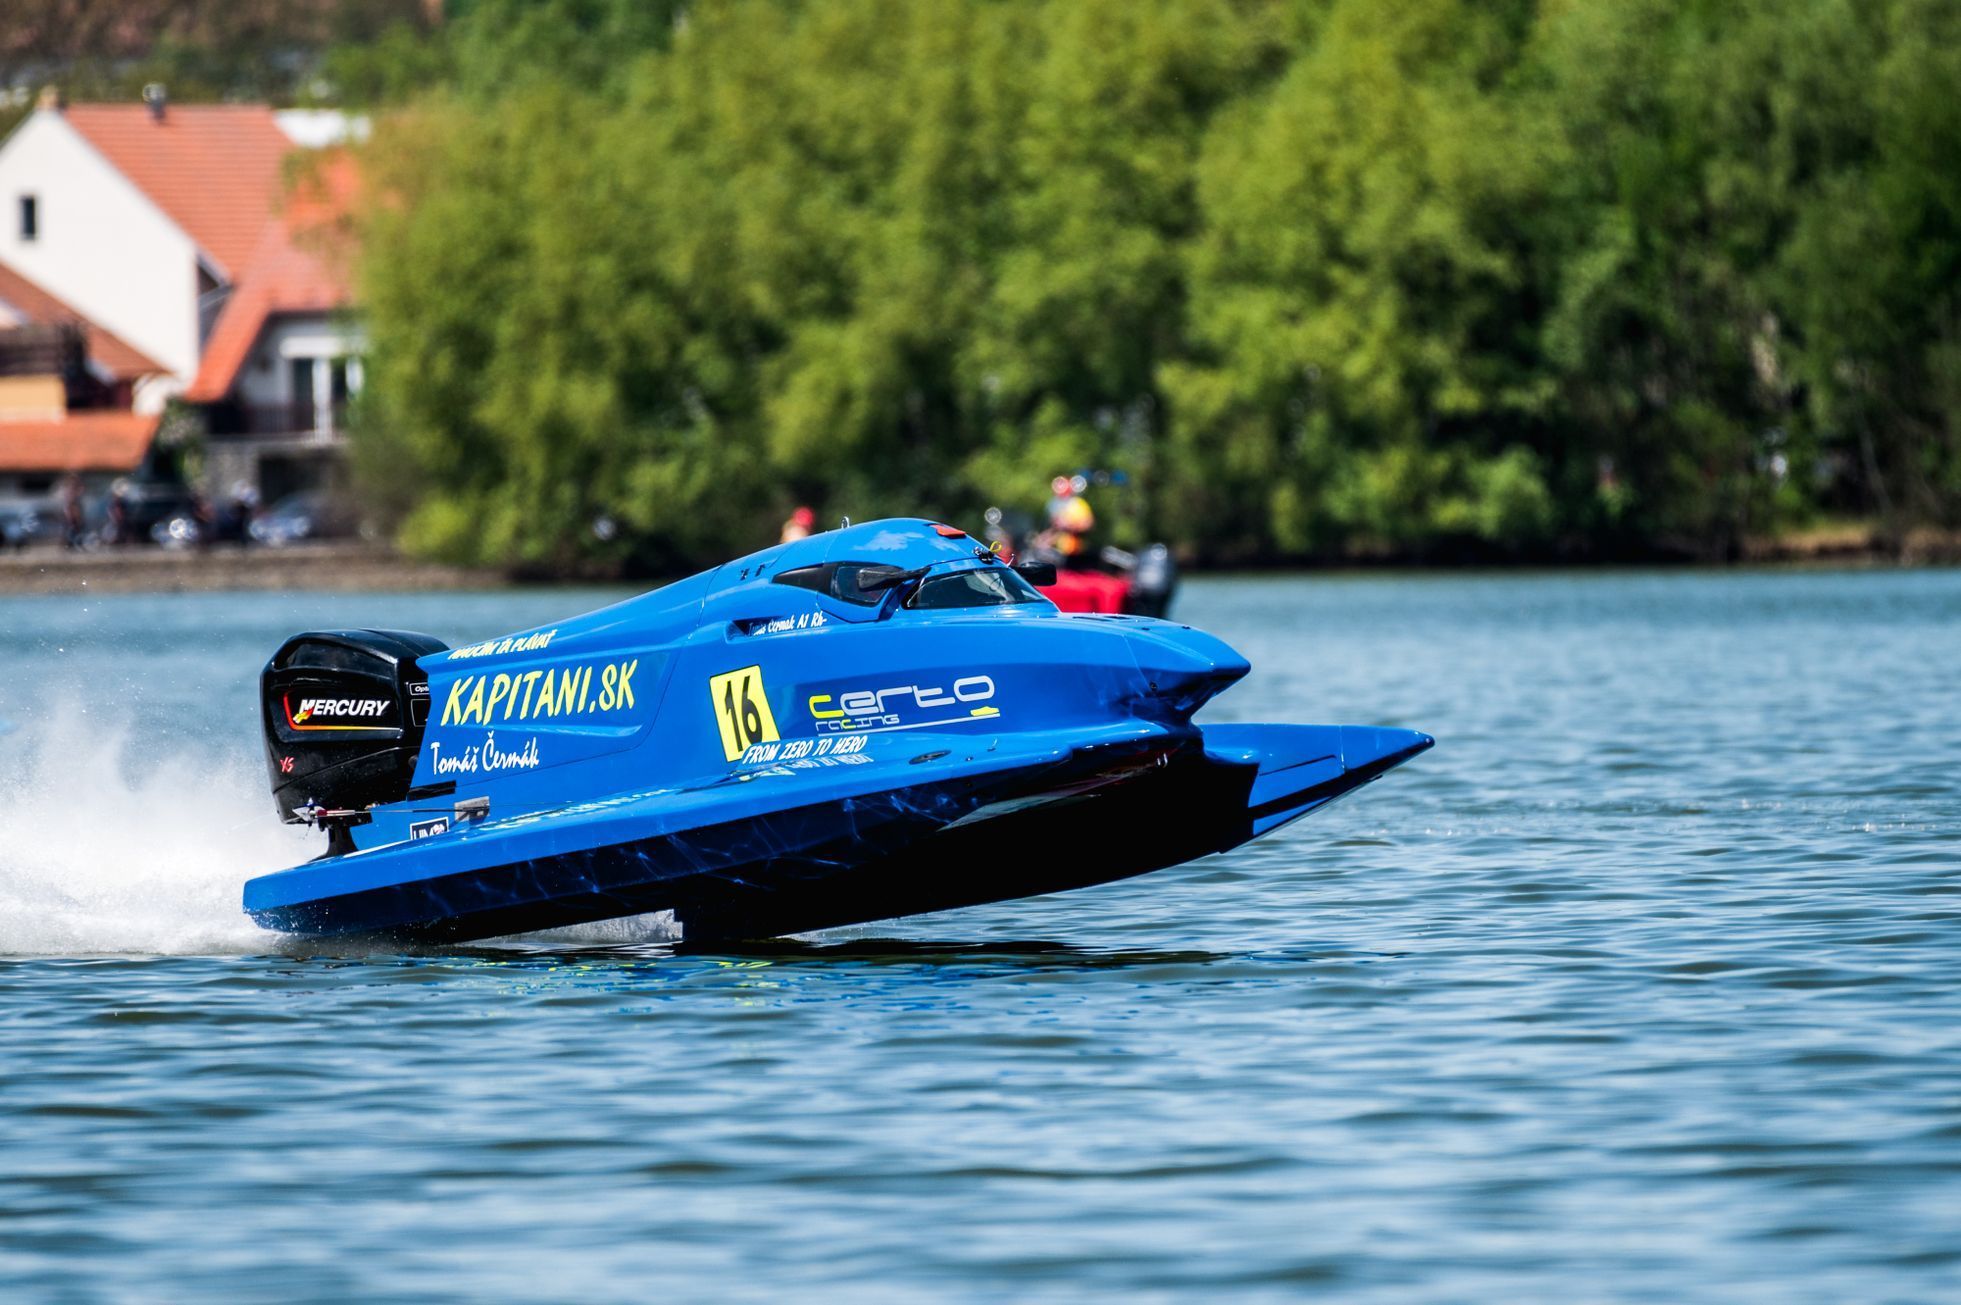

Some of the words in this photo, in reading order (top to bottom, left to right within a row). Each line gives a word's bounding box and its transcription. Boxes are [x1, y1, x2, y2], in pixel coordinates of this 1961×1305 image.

[299, 699, 390, 717] MERCURY
[440, 658, 638, 727] KAPITANI.SK
[724, 675, 763, 753] 16
[809, 675, 995, 719] certo
[430, 741, 480, 775] Tomáš
[482, 730, 540, 772] Čermák
[742, 743, 781, 765] FROM
[779, 740, 814, 761] ZERO
[812, 738, 833, 757] TO
[829, 735, 868, 755] HERO
